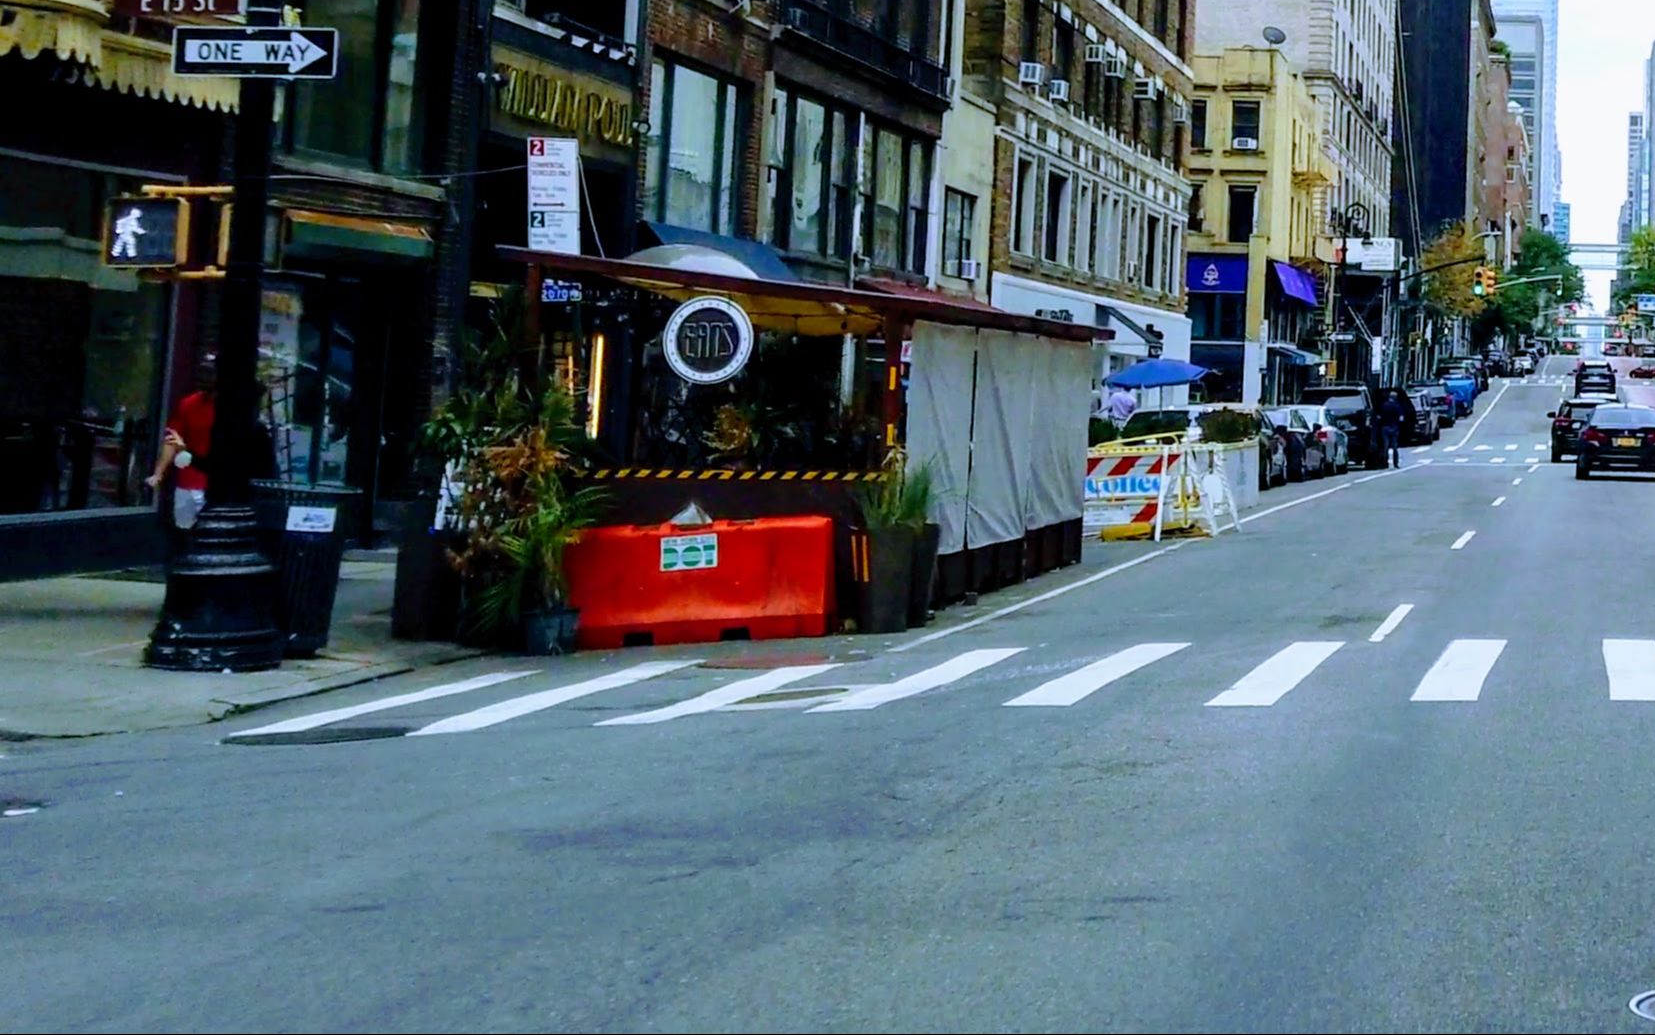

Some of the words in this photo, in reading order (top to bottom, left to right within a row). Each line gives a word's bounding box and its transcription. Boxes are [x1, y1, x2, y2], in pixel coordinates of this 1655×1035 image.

[198, 43, 243, 61] ONE
[264, 44, 311, 61] WAY
[532, 140, 543, 155] 2
[533, 213, 543, 227] 2
[684, 322, 734, 358] EATS
